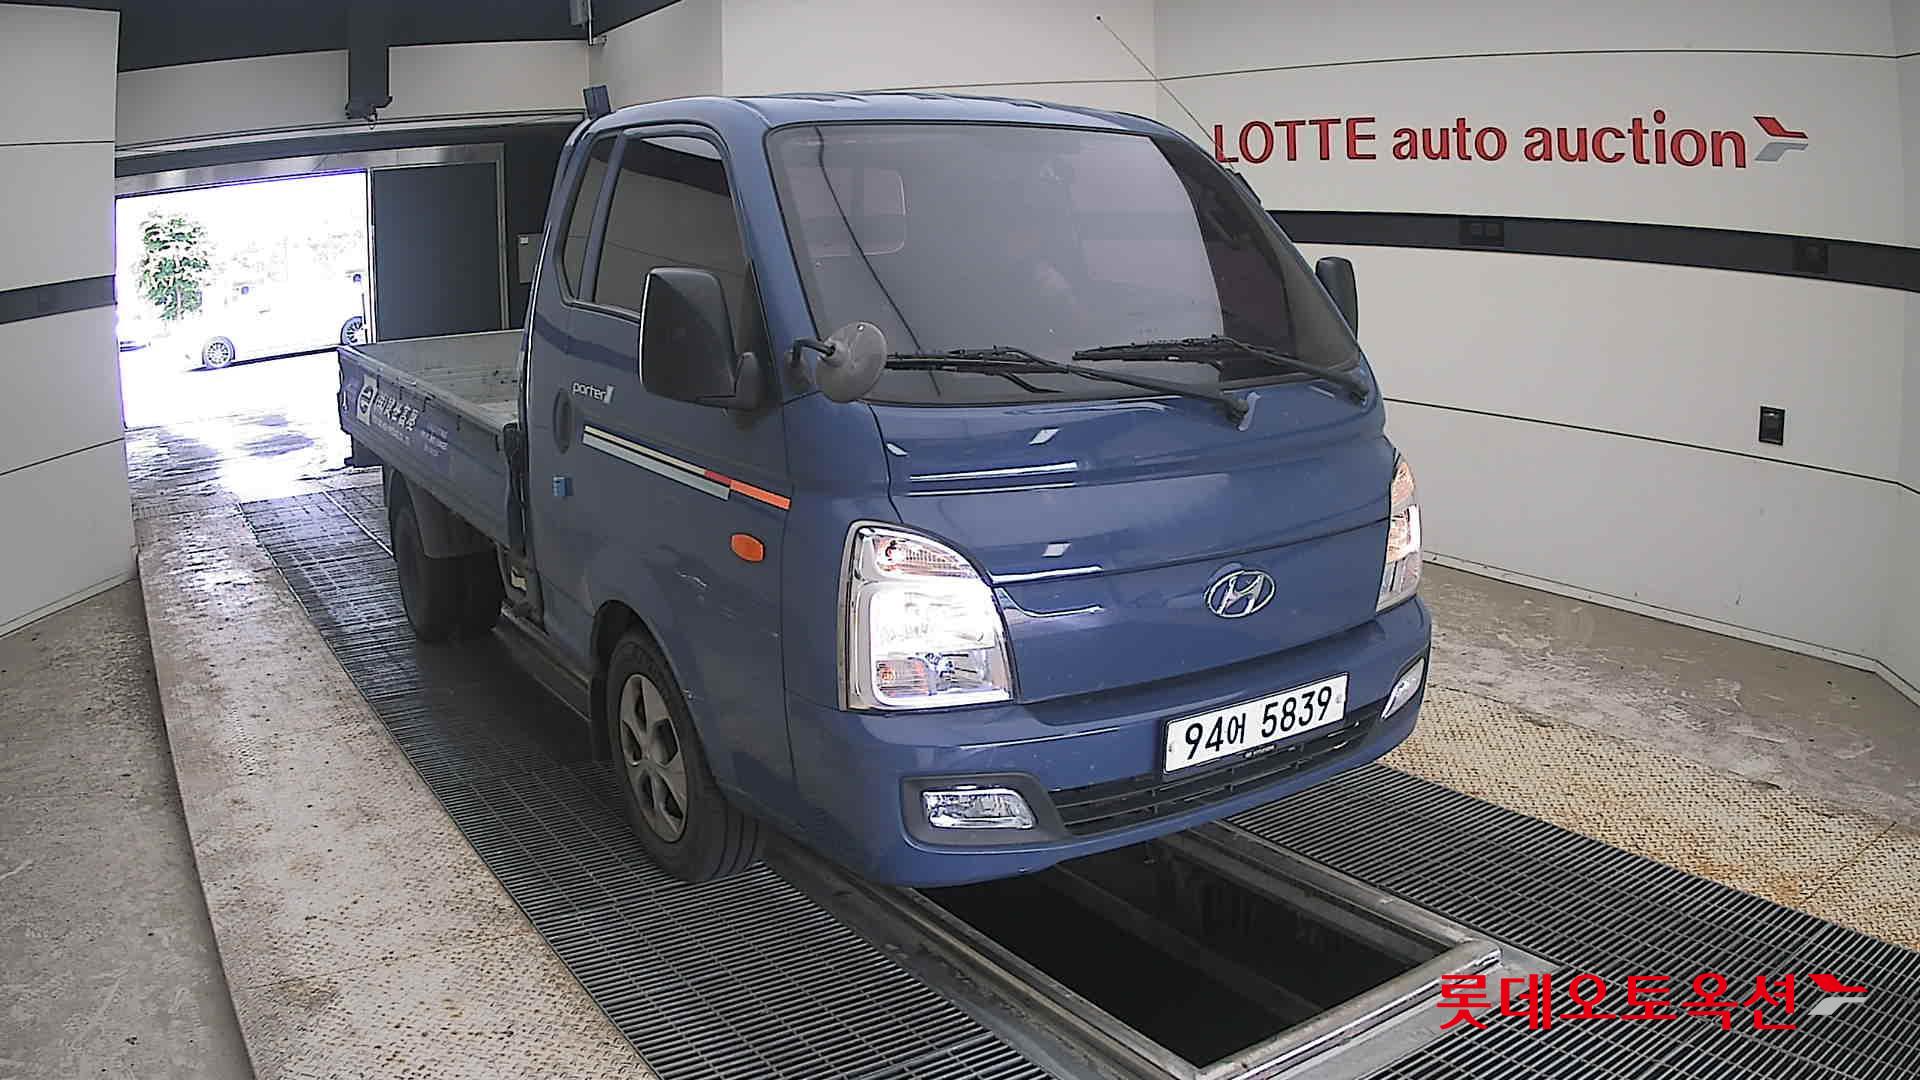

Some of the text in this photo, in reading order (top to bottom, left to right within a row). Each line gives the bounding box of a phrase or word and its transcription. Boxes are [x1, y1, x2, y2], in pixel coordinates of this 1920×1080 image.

[1213, 110, 1747, 169] LOTTE auto auction
[1185, 686, 1332, 760] 94어 5839
